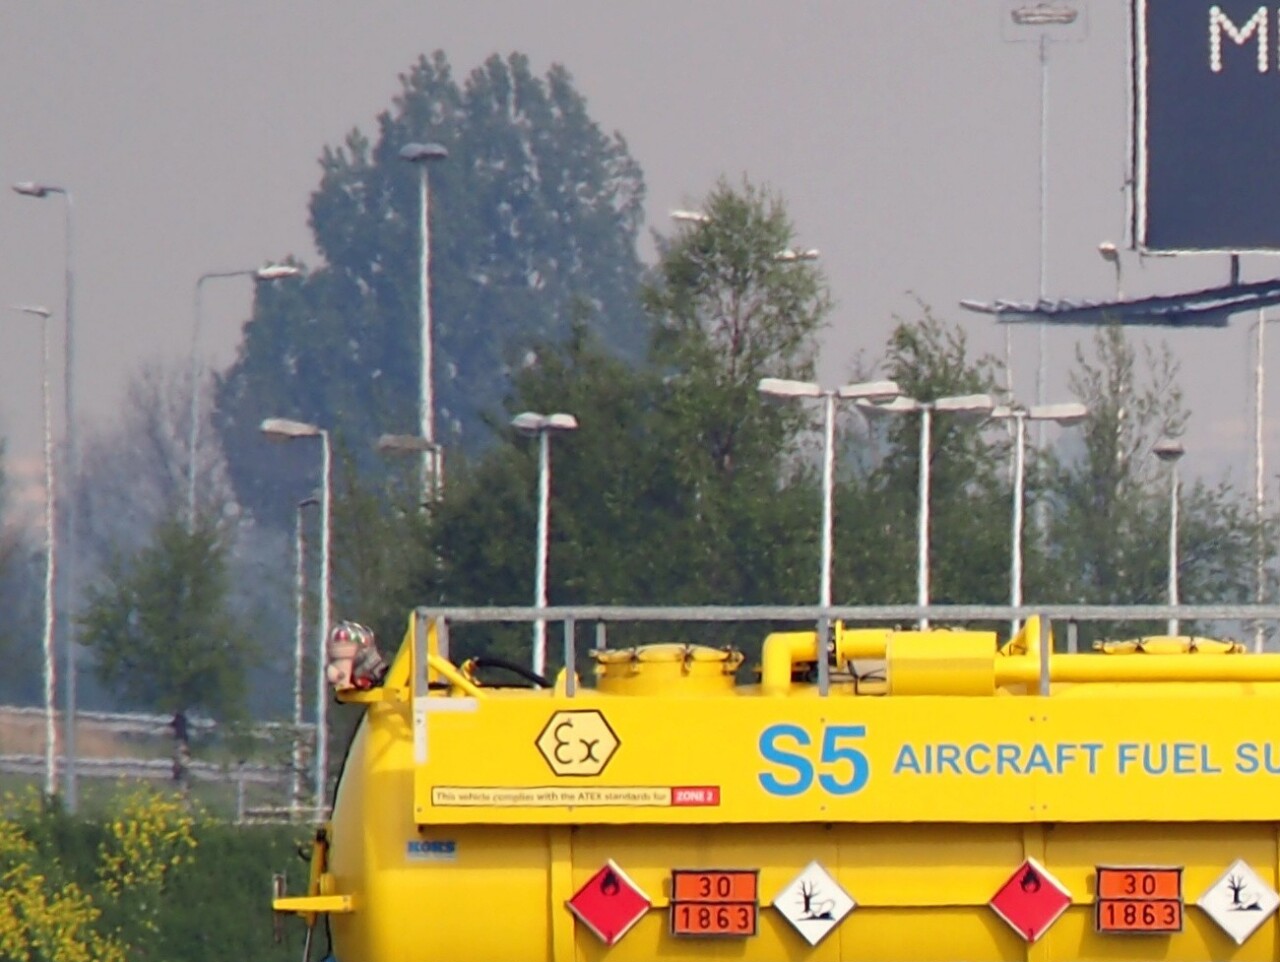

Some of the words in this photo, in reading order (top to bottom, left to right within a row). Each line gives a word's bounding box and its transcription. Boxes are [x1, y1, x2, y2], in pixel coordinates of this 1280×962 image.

[553, 721, 600, 765] Ex
[757, 723, 871, 797] S5
[892, 743, 1104, 775] AIRCRAFT
[1117, 743, 1222, 774] FUEL
[436, 791, 456, 801] This
[458, 791, 490, 801] vehicle
[492, 791, 534, 803] complies
[536, 791, 558, 801] with
[560, 791, 576, 801] the
[577, 791, 602, 801] ATEX
[604, 791, 651, 801] standards
[676, 790, 704, 803] ZONE
[699, 876, 731, 898] 30
[1123, 874, 1156, 895] 30
[682, 906, 749, 930] 1863
[1107, 903, 1175, 926] 1863
